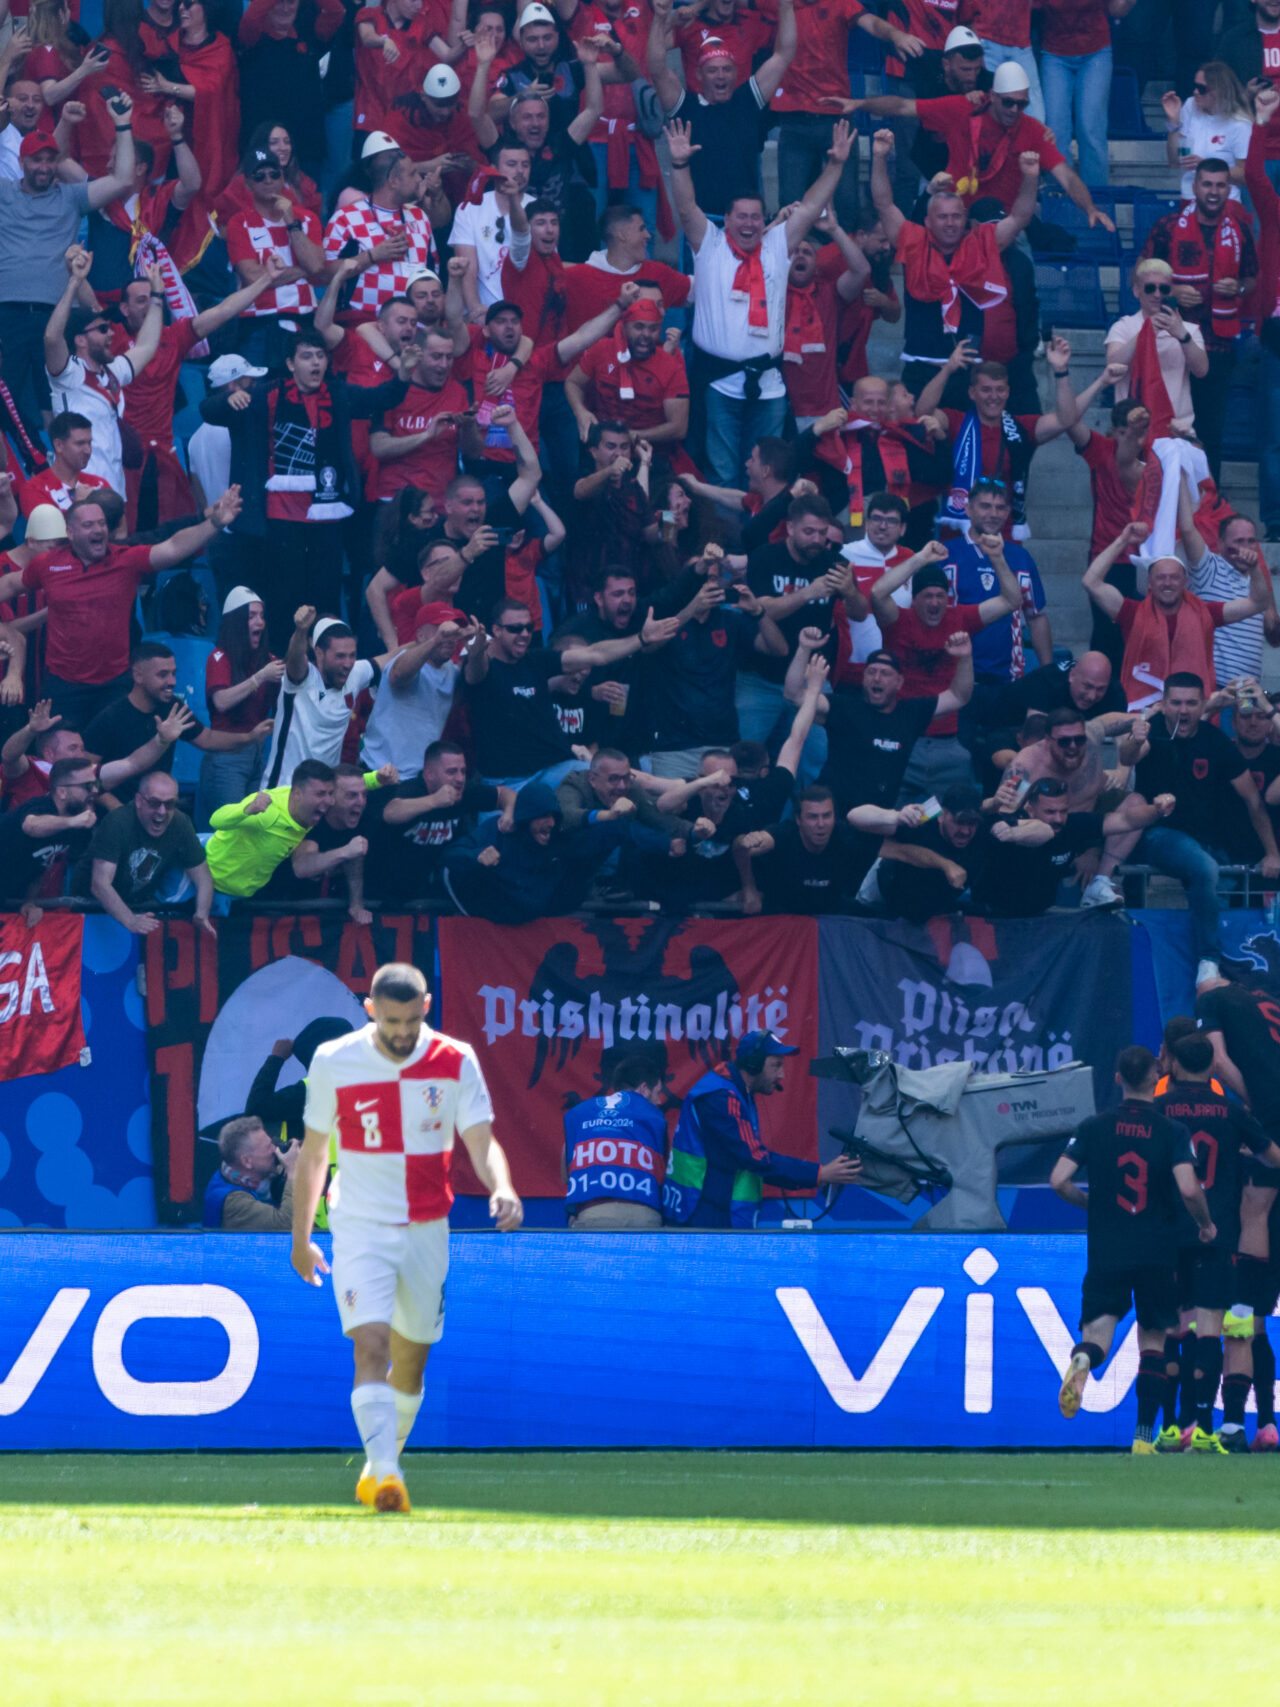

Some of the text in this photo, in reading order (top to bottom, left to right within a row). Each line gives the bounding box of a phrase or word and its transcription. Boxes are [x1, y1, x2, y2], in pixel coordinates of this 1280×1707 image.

[1263, 47, 1280, 68] 10
[360, 1112, 382, 1149] 8
[573, 1140, 654, 1170] HOTO
[1116, 1150, 1149, 1216] 3
